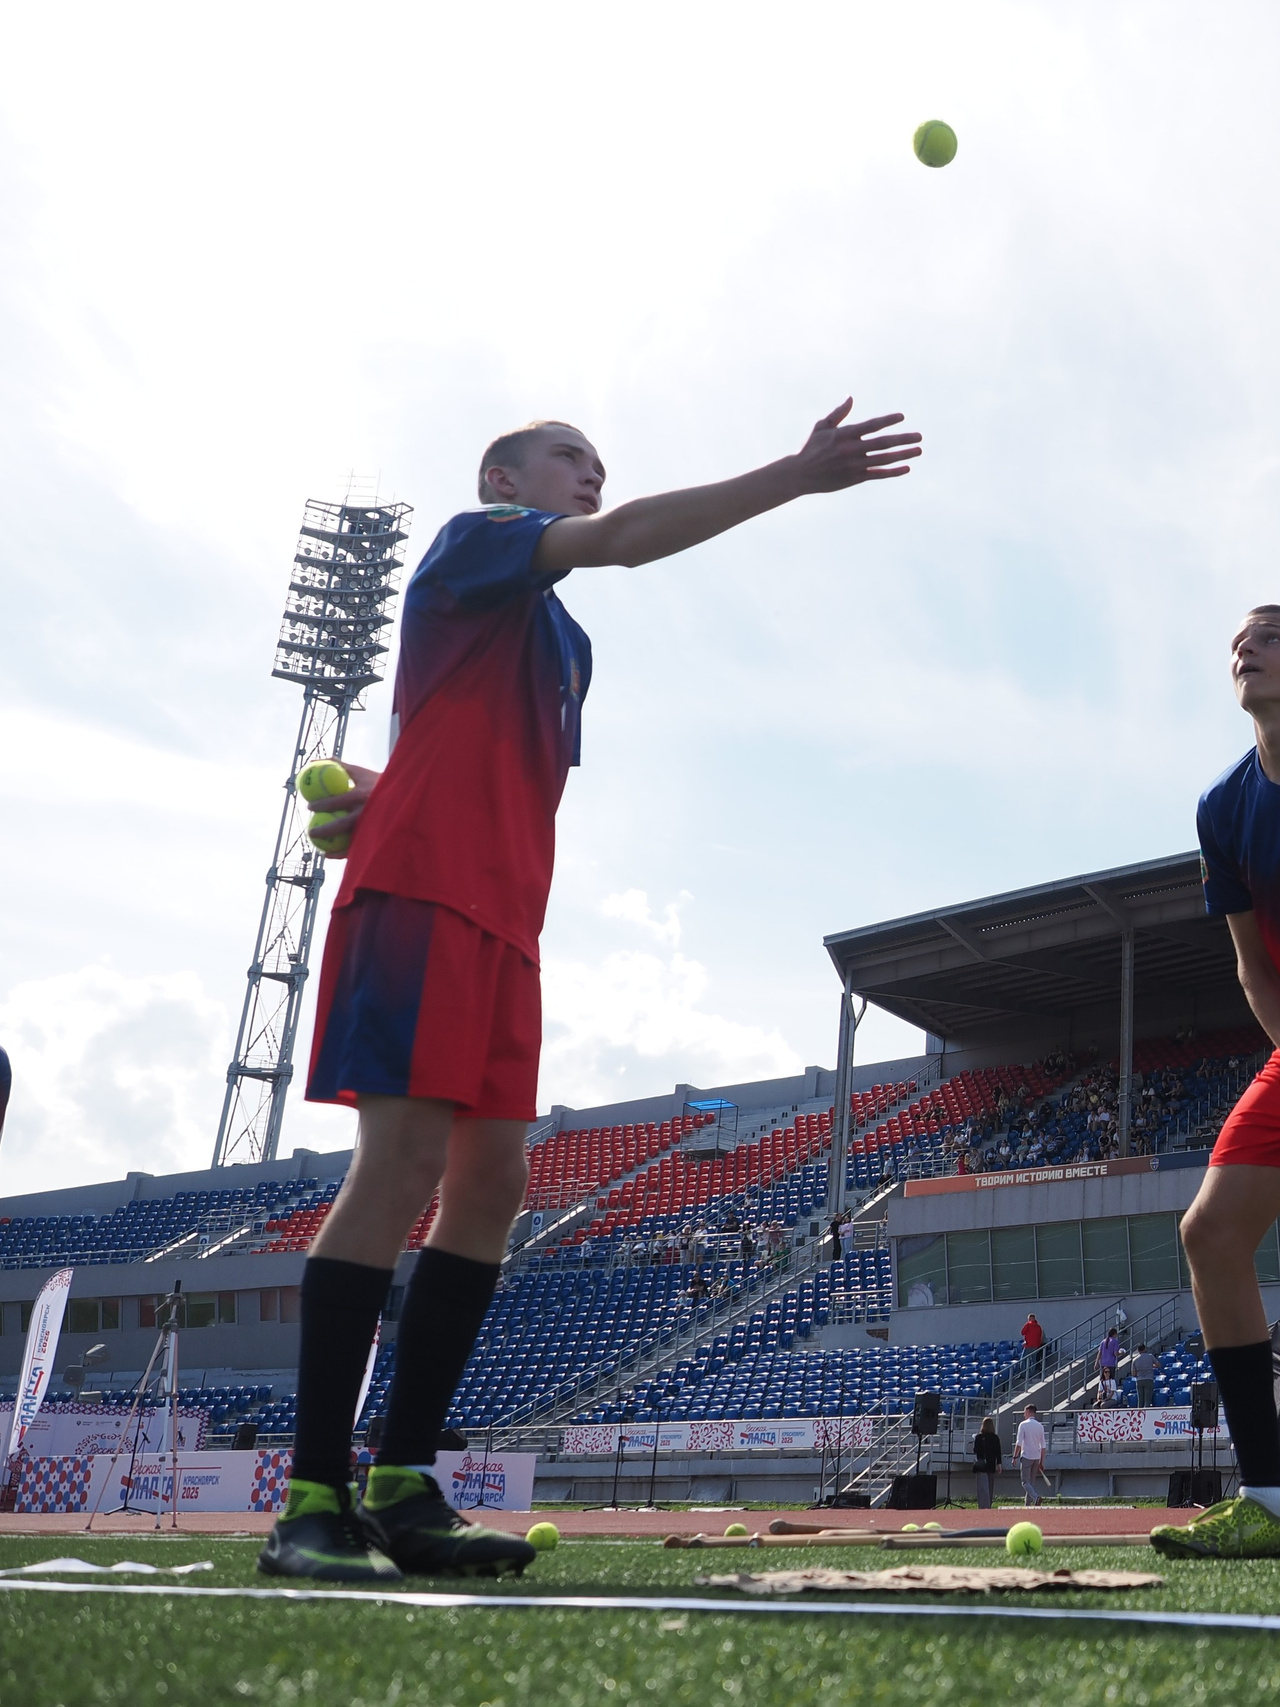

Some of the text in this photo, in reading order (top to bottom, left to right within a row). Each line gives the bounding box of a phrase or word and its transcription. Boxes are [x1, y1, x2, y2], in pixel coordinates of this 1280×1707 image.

[975, 1165, 1108, 1187] ТВОРИМ ИСТОРИЮ ВМЕСТЕ
[1164, 1421, 1198, 1435] ЛАПТ
[181, 1487, 200, 1500] 2025
